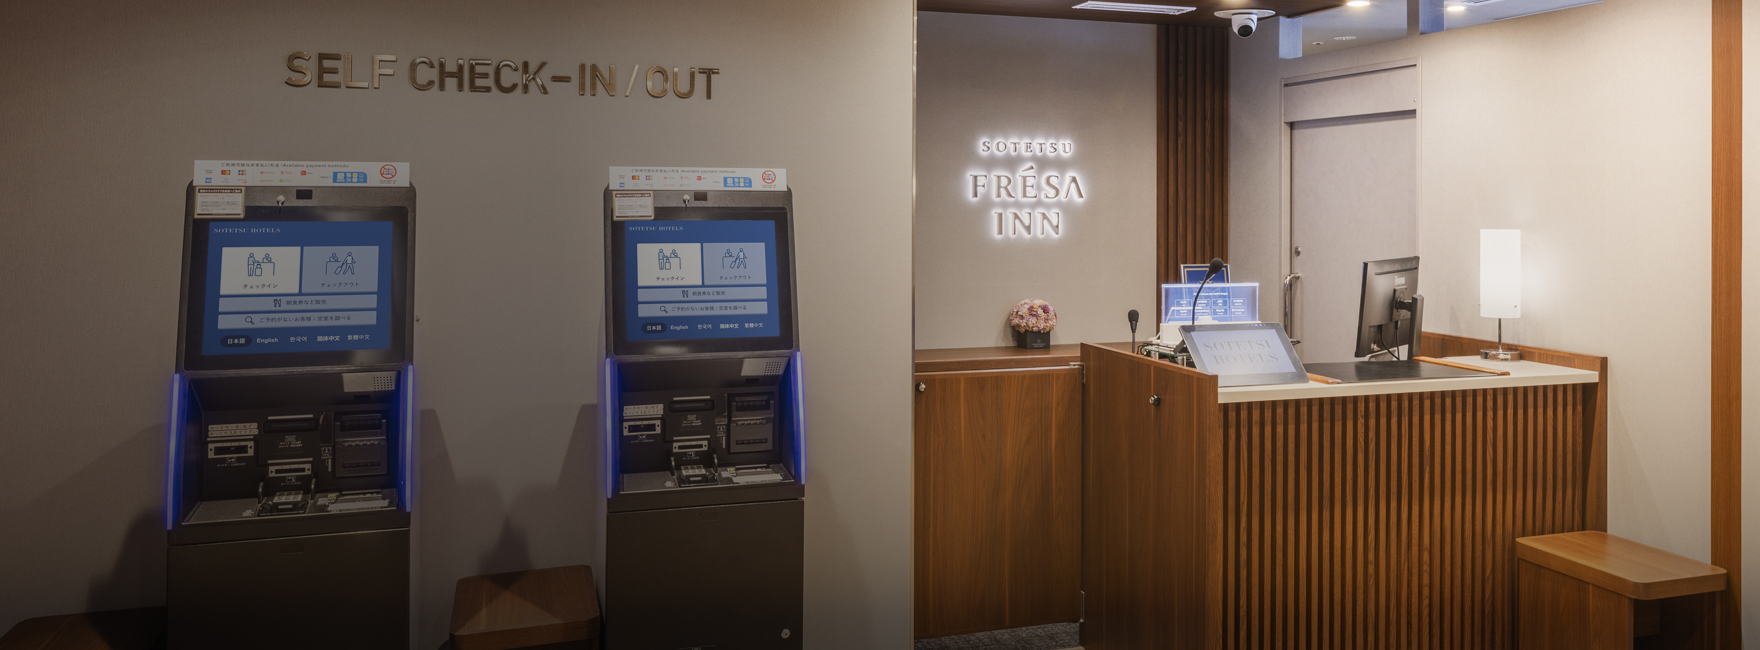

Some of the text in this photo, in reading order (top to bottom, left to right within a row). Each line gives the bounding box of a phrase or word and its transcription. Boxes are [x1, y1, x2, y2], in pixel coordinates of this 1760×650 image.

[284, 51, 398, 90] SELF
[981, 140, 1073, 154] SOTETSU
[969, 164, 1084, 200] FRÉSA
[994, 211, 1060, 236] INN
[227, 337, 246, 345] 日本語
[256, 337, 279, 345] English
[1203, 339, 1276, 352] SOTETSU
[1212, 352, 1279, 365] HOTELS
